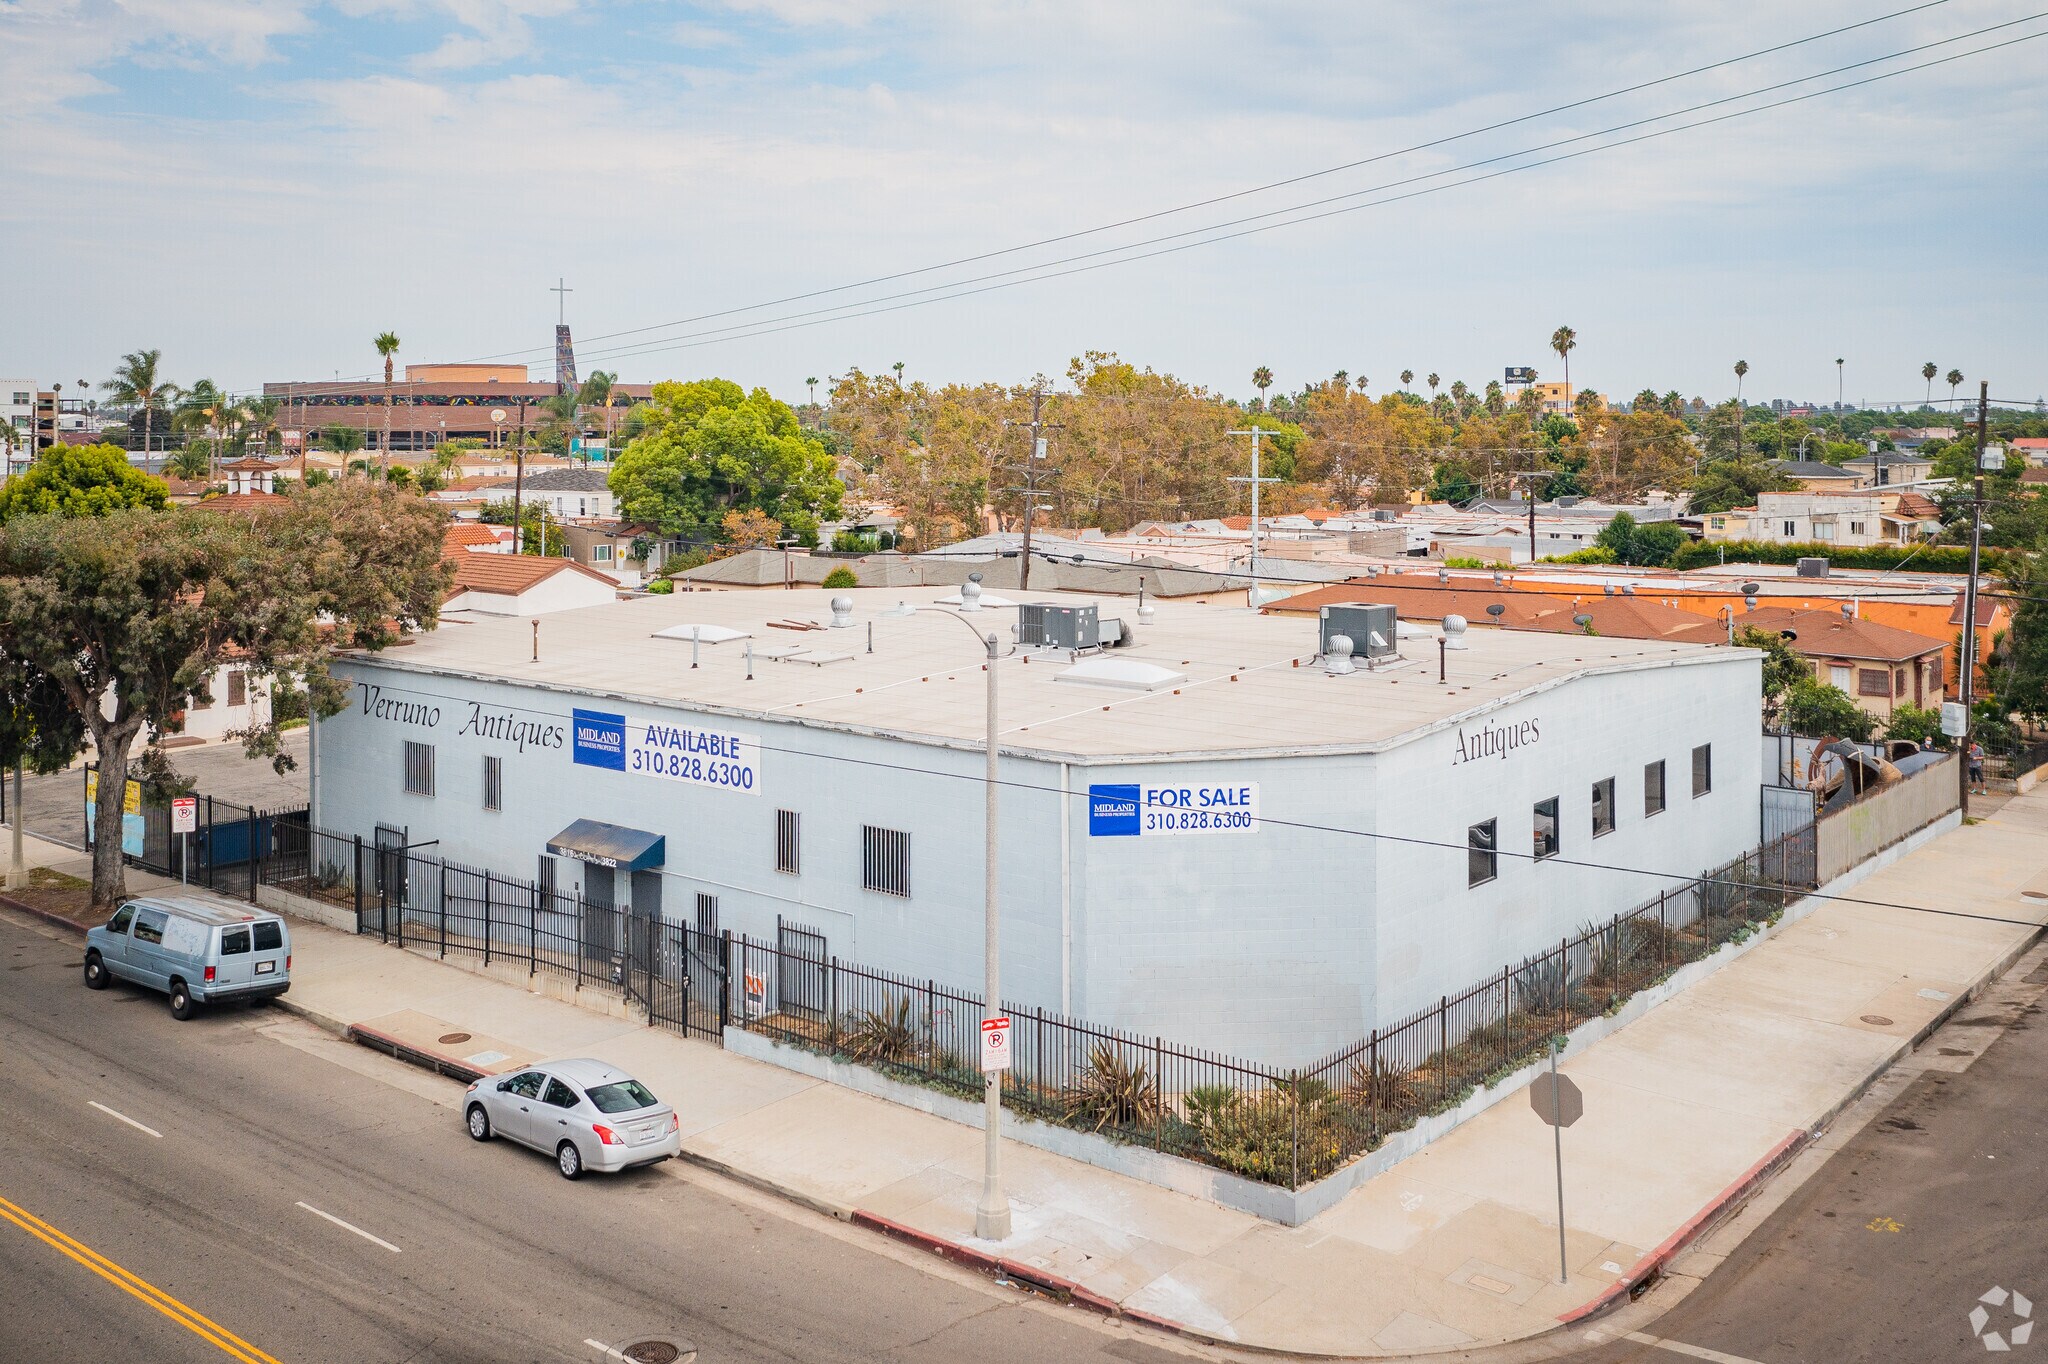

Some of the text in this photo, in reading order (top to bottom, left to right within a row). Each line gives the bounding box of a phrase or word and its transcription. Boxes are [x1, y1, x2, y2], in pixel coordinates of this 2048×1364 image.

[357, 683, 565, 753] Verruno Antiques
[577, 726, 621, 745] MIDLAND
[645, 724, 740, 760] AVAILABLE
[1452, 717, 1540, 766] Antiques
[596, 742, 621, 753] PROPERTIES
[632, 748, 753, 789] 310.828.6300
[1094, 803, 1136, 811] MIDLAND
[1147, 787, 1250, 808] FOR SALE
[1146, 811, 1252, 830] 310.828.6300
